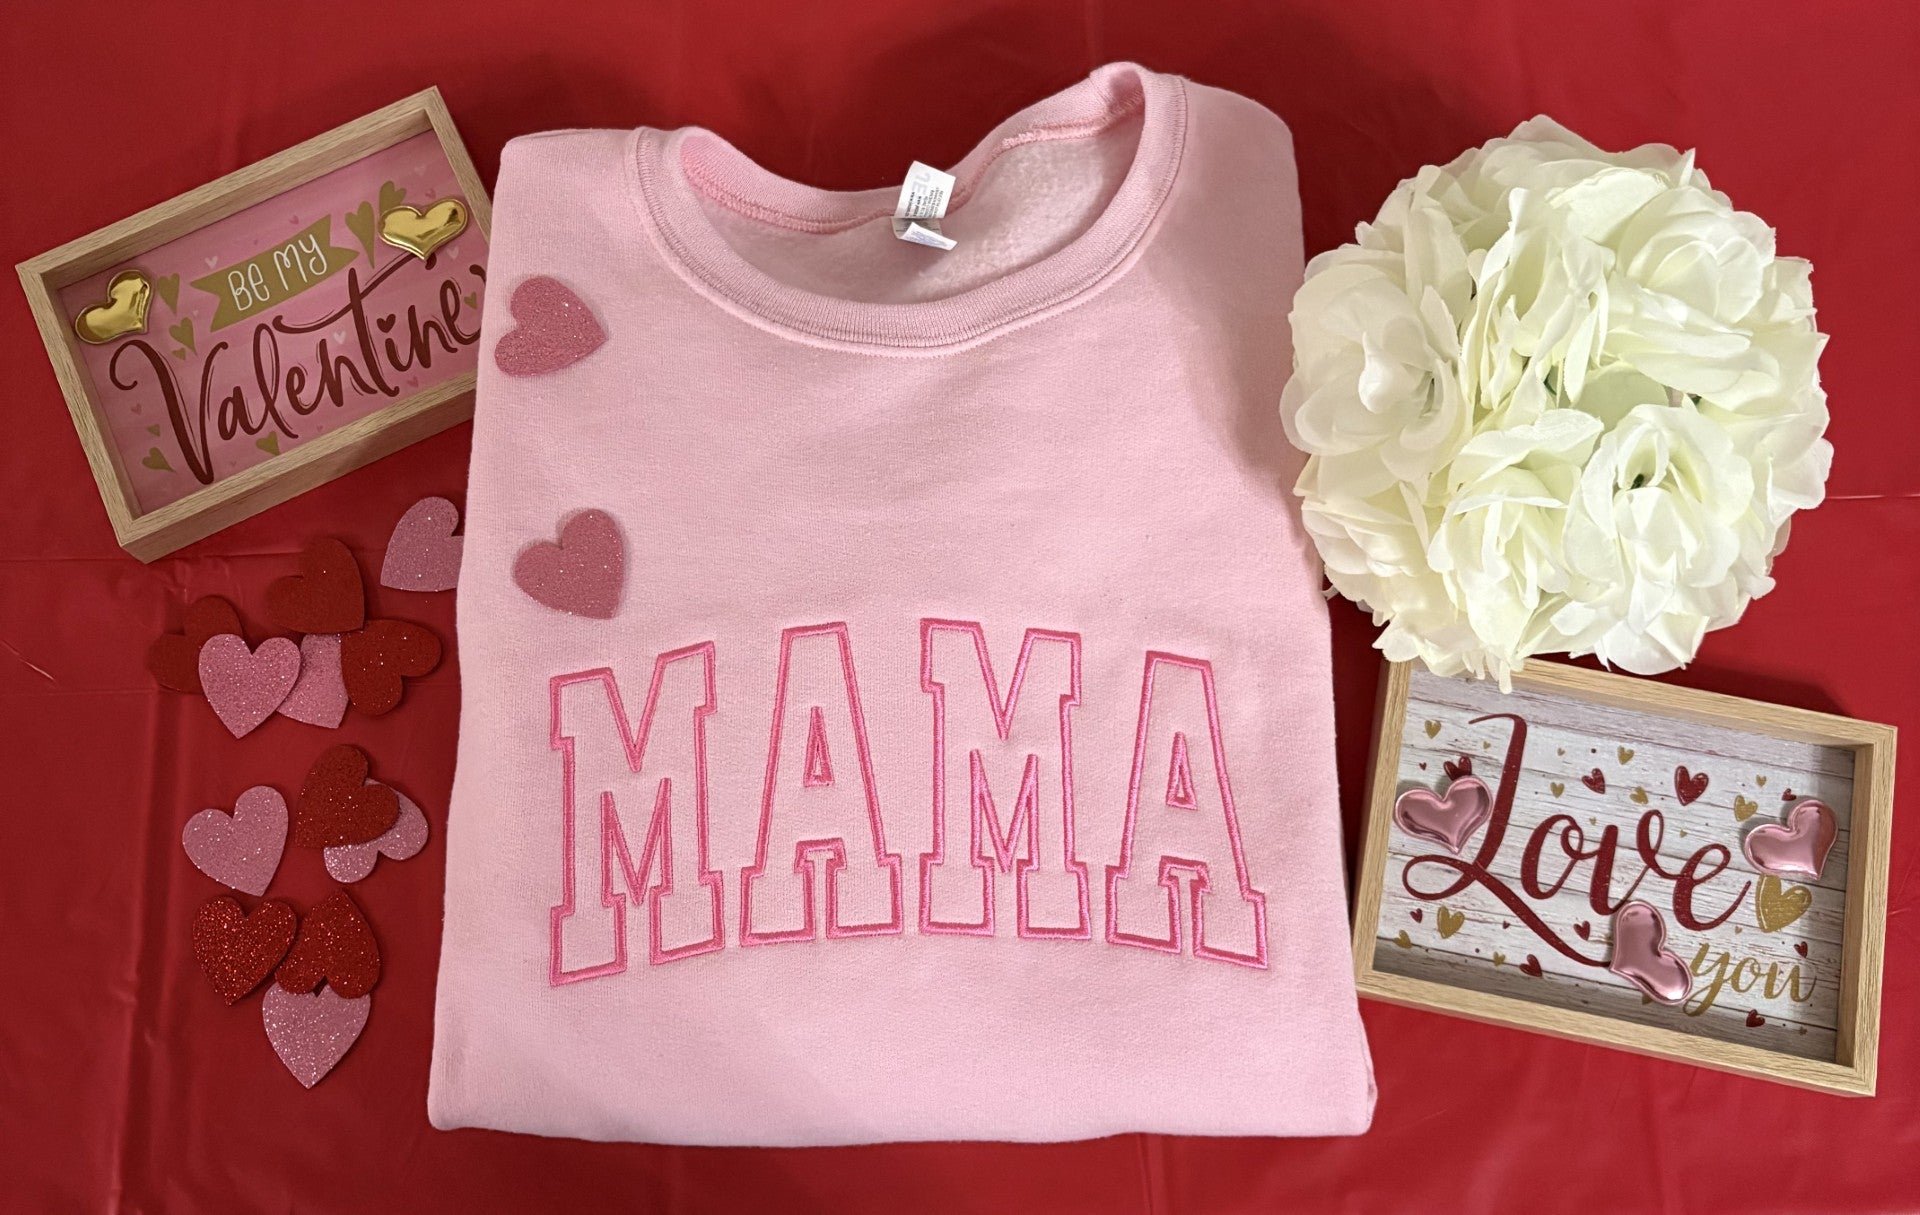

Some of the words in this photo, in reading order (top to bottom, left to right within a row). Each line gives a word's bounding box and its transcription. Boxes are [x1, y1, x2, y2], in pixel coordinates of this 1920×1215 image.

[109, 253, 486, 485] Valentine
[550, 618, 1268, 986] MAMA
[1402, 713, 1751, 968] Love
[1683, 943, 1817, 1016] you
